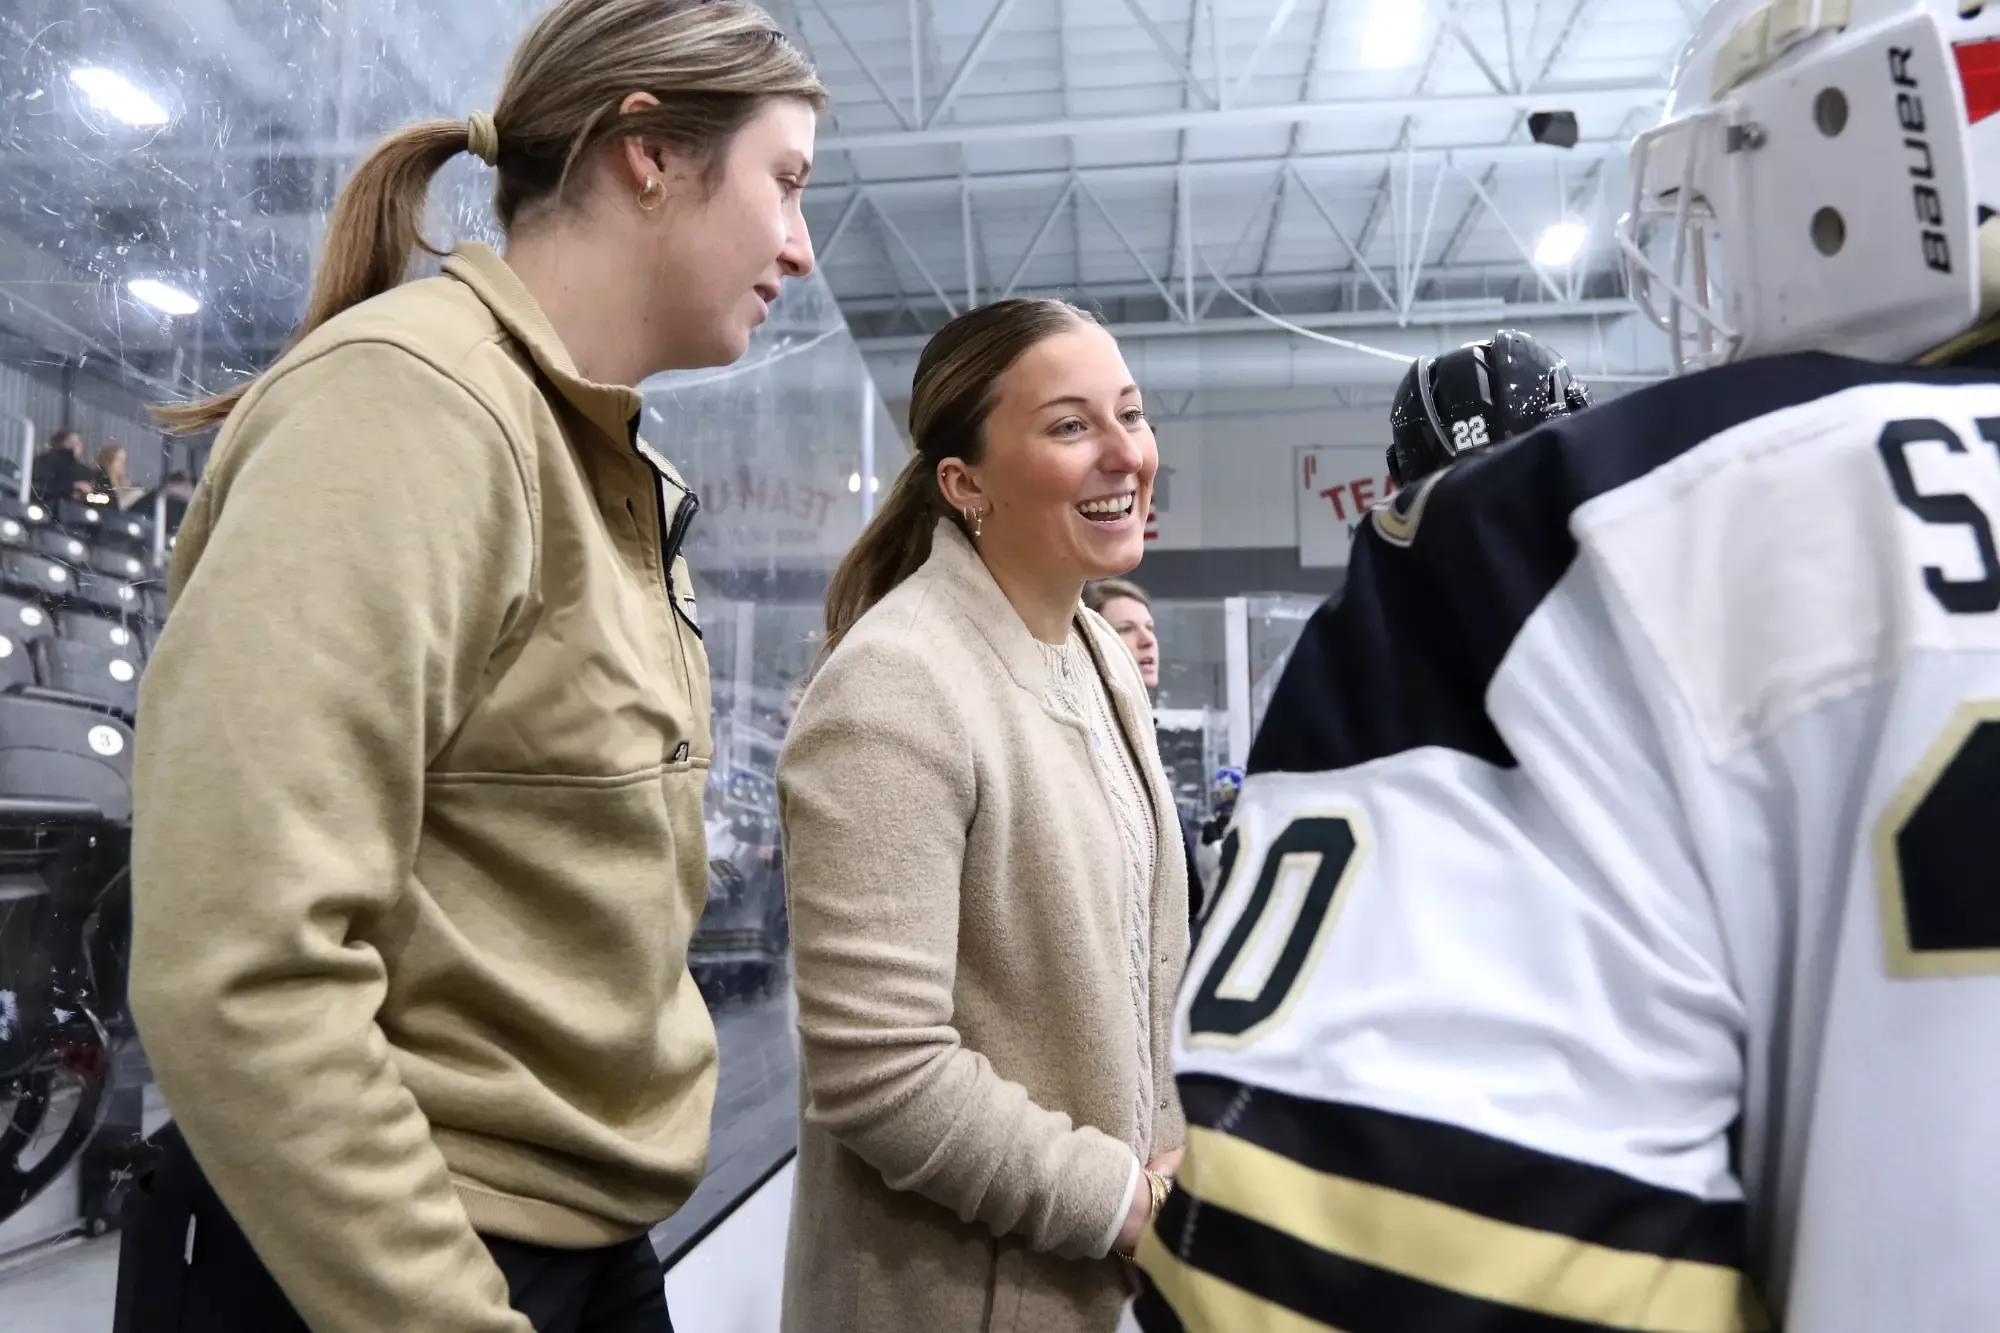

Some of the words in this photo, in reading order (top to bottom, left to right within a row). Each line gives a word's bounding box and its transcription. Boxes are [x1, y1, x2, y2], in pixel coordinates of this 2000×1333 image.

[1887, 46, 1953, 274] BAUER
[1451, 414, 1490, 451] 22
[1190, 813, 1360, 1040] 0
